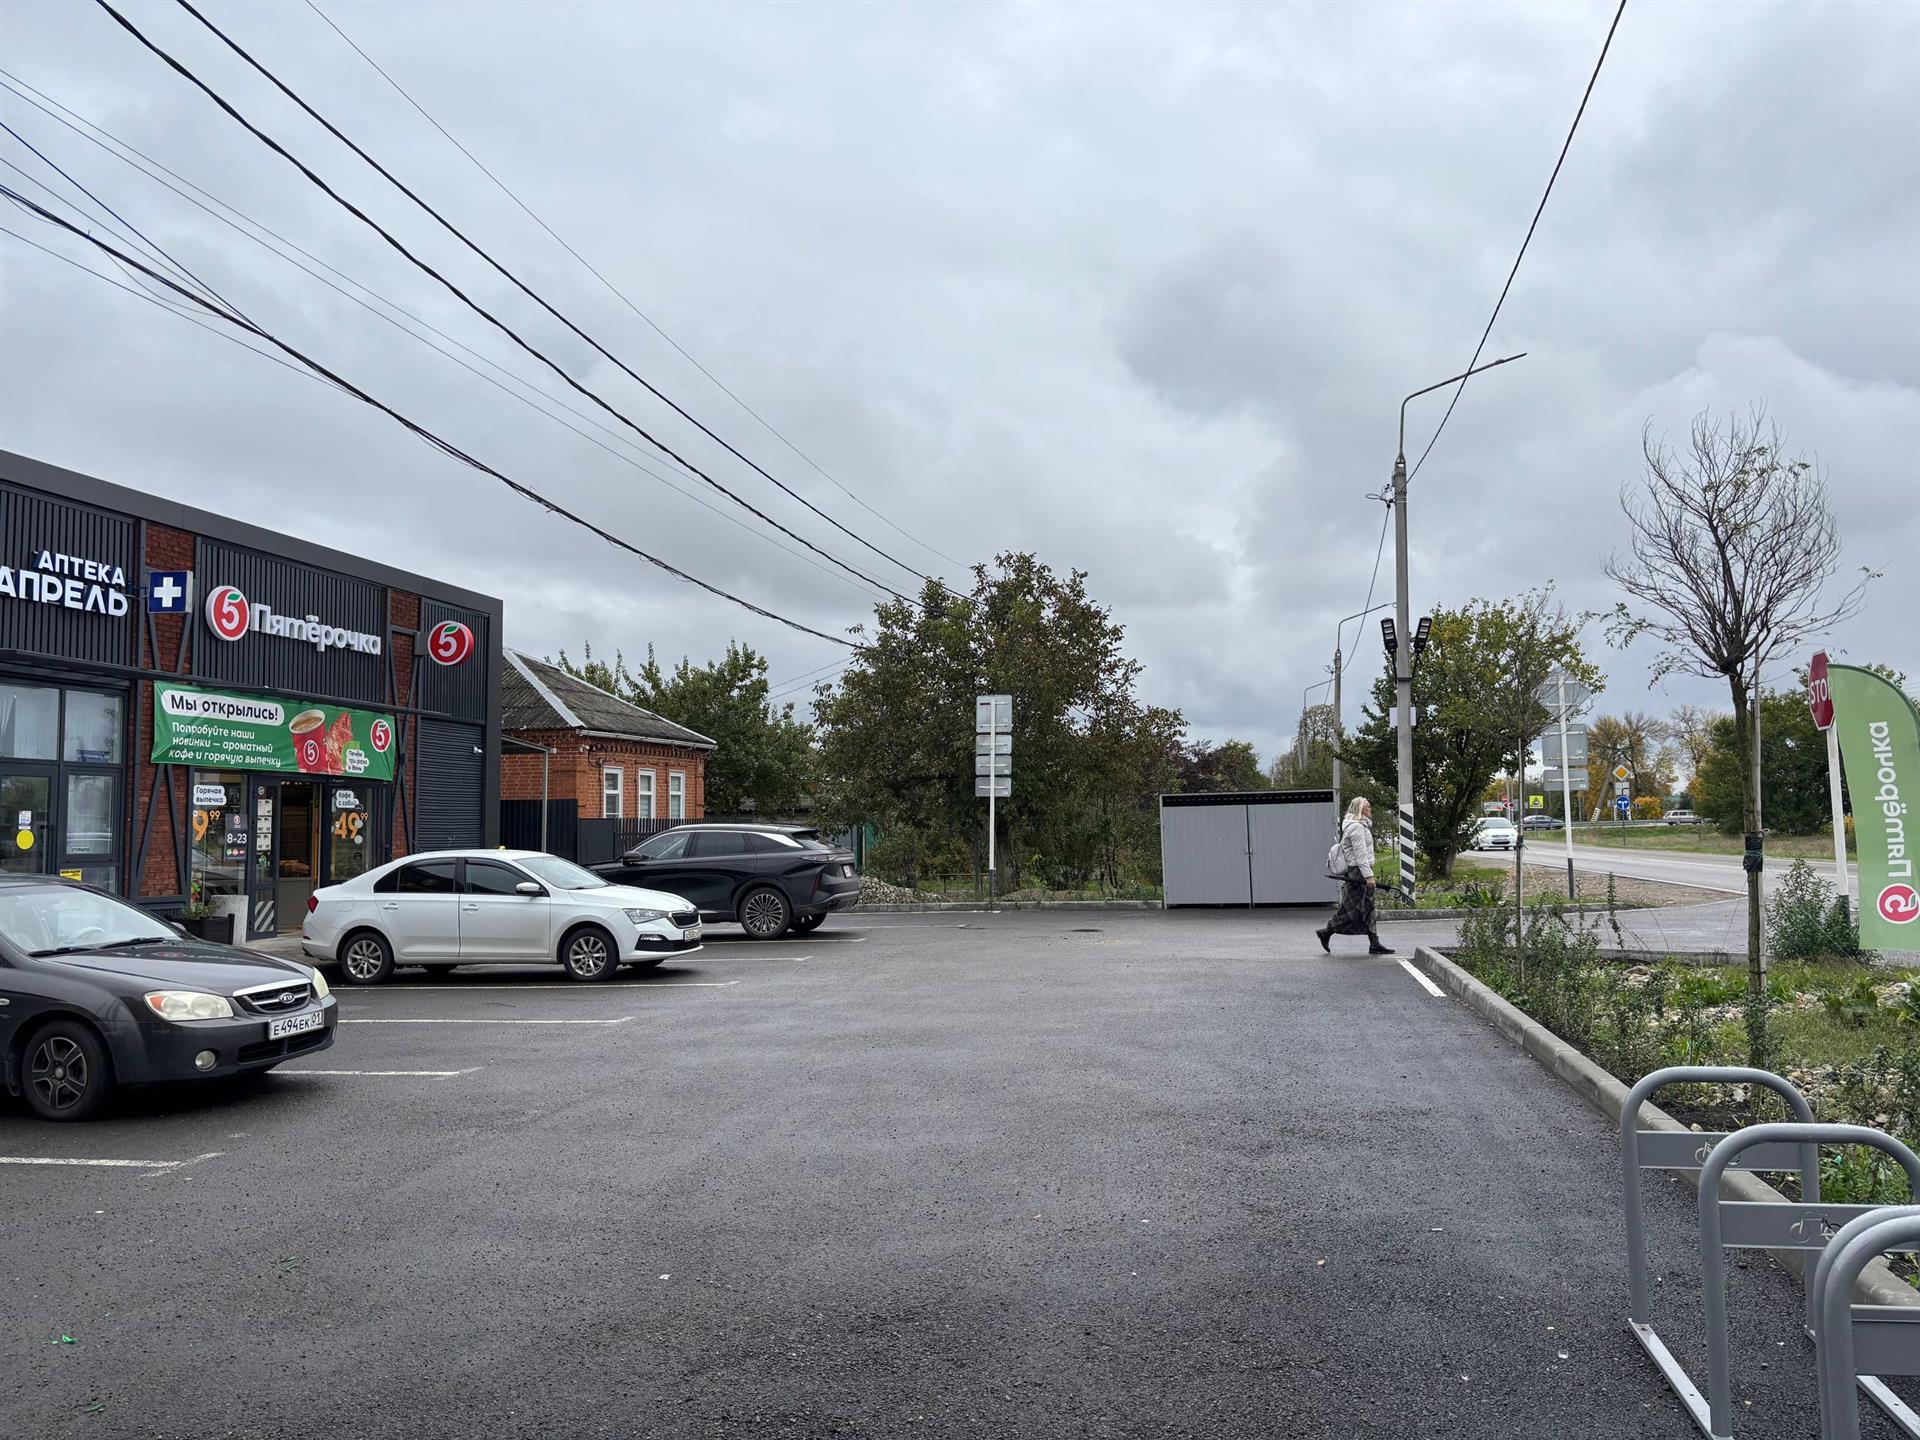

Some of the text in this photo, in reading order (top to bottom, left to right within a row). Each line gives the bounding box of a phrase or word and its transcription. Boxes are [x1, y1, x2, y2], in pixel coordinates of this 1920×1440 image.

[37, 550, 126, 588] АПТЕКА
[0, 565, 129, 617] АПРЕЛЬ
[250, 602, 382, 655] Пятёрочка
[1810, 678, 1831, 705] STO
[171, 694, 278, 721] Мы открылись!
[172, 722, 255, 740] Попробуйте наши
[168, 748, 281, 768] кофе и горячую выпечку
[172, 737, 211, 748] новинки
[222, 740, 273, 753] ароматный
[196, 787, 222, 795] Горячая
[192, 810, 221, 841] 9 99
[226, 833, 247, 844] 8-23
[335, 812, 359, 839] 49
